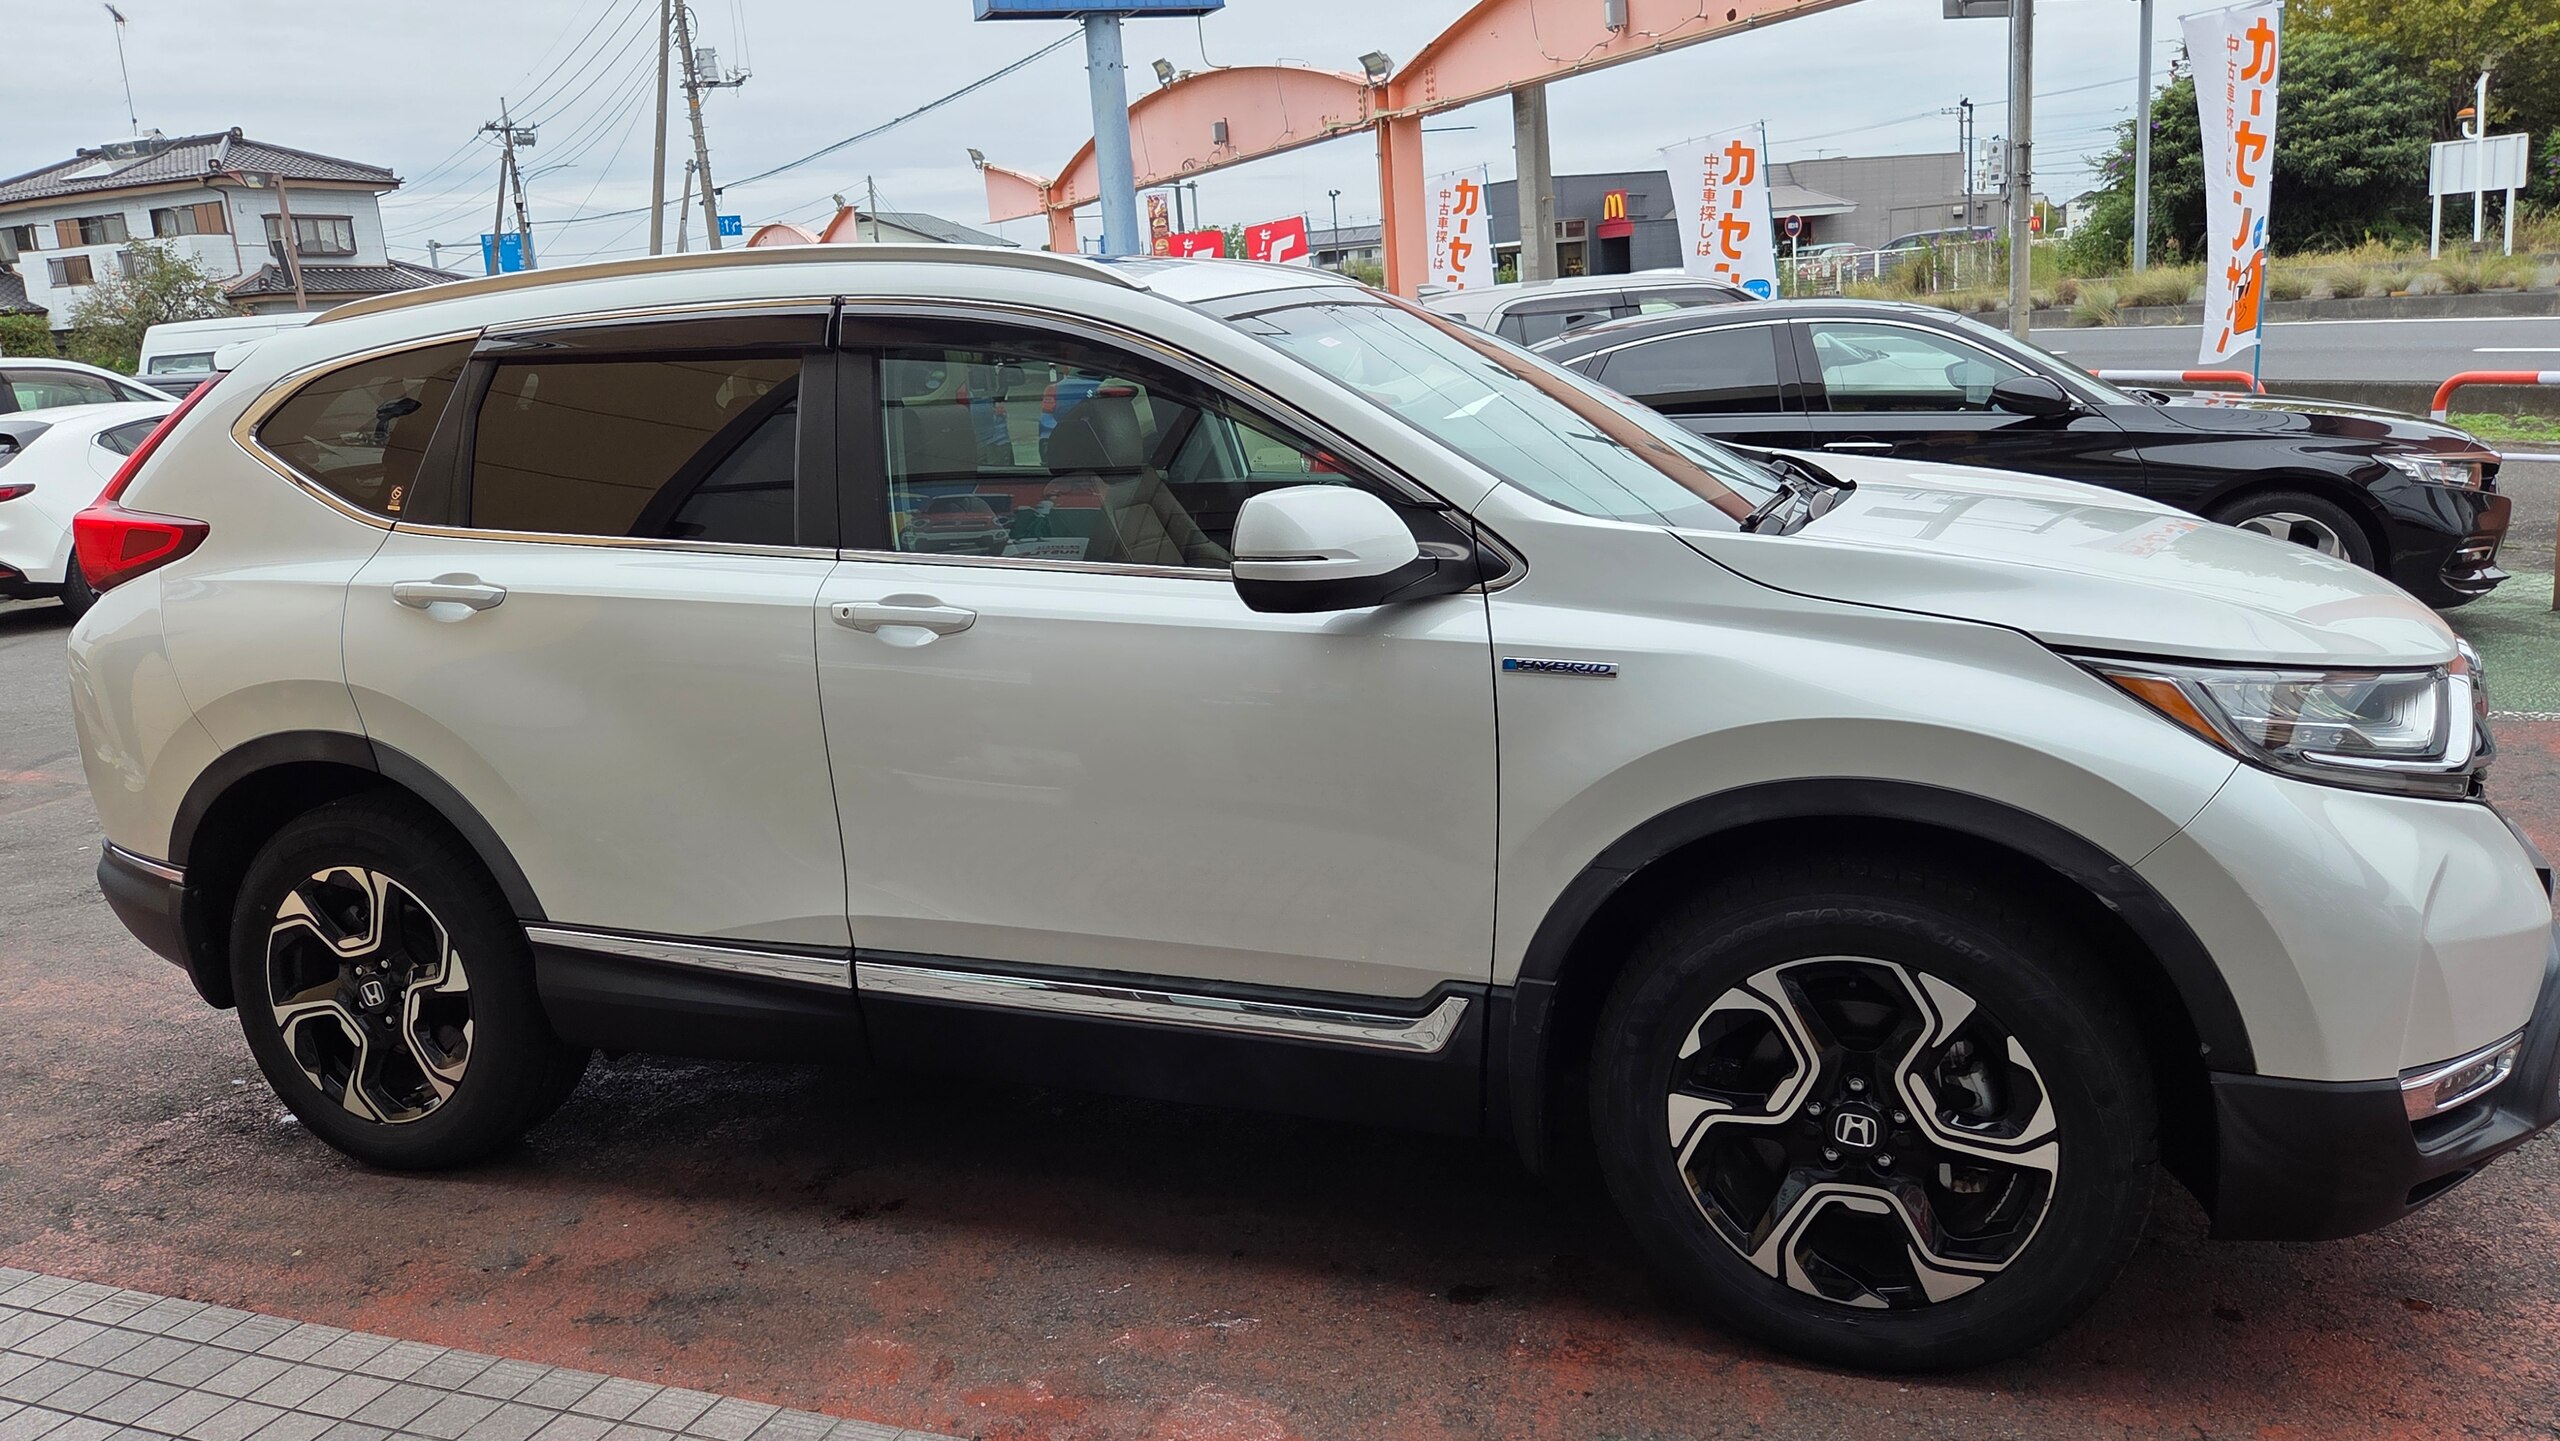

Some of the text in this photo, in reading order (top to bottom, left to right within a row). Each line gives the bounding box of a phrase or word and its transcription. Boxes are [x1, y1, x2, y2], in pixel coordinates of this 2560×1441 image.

[1433, 188, 1452, 270] 中古車探しは
[1696, 152, 1719, 257] 中古車探しは
[1516, 659, 1612, 675] HYBRID
